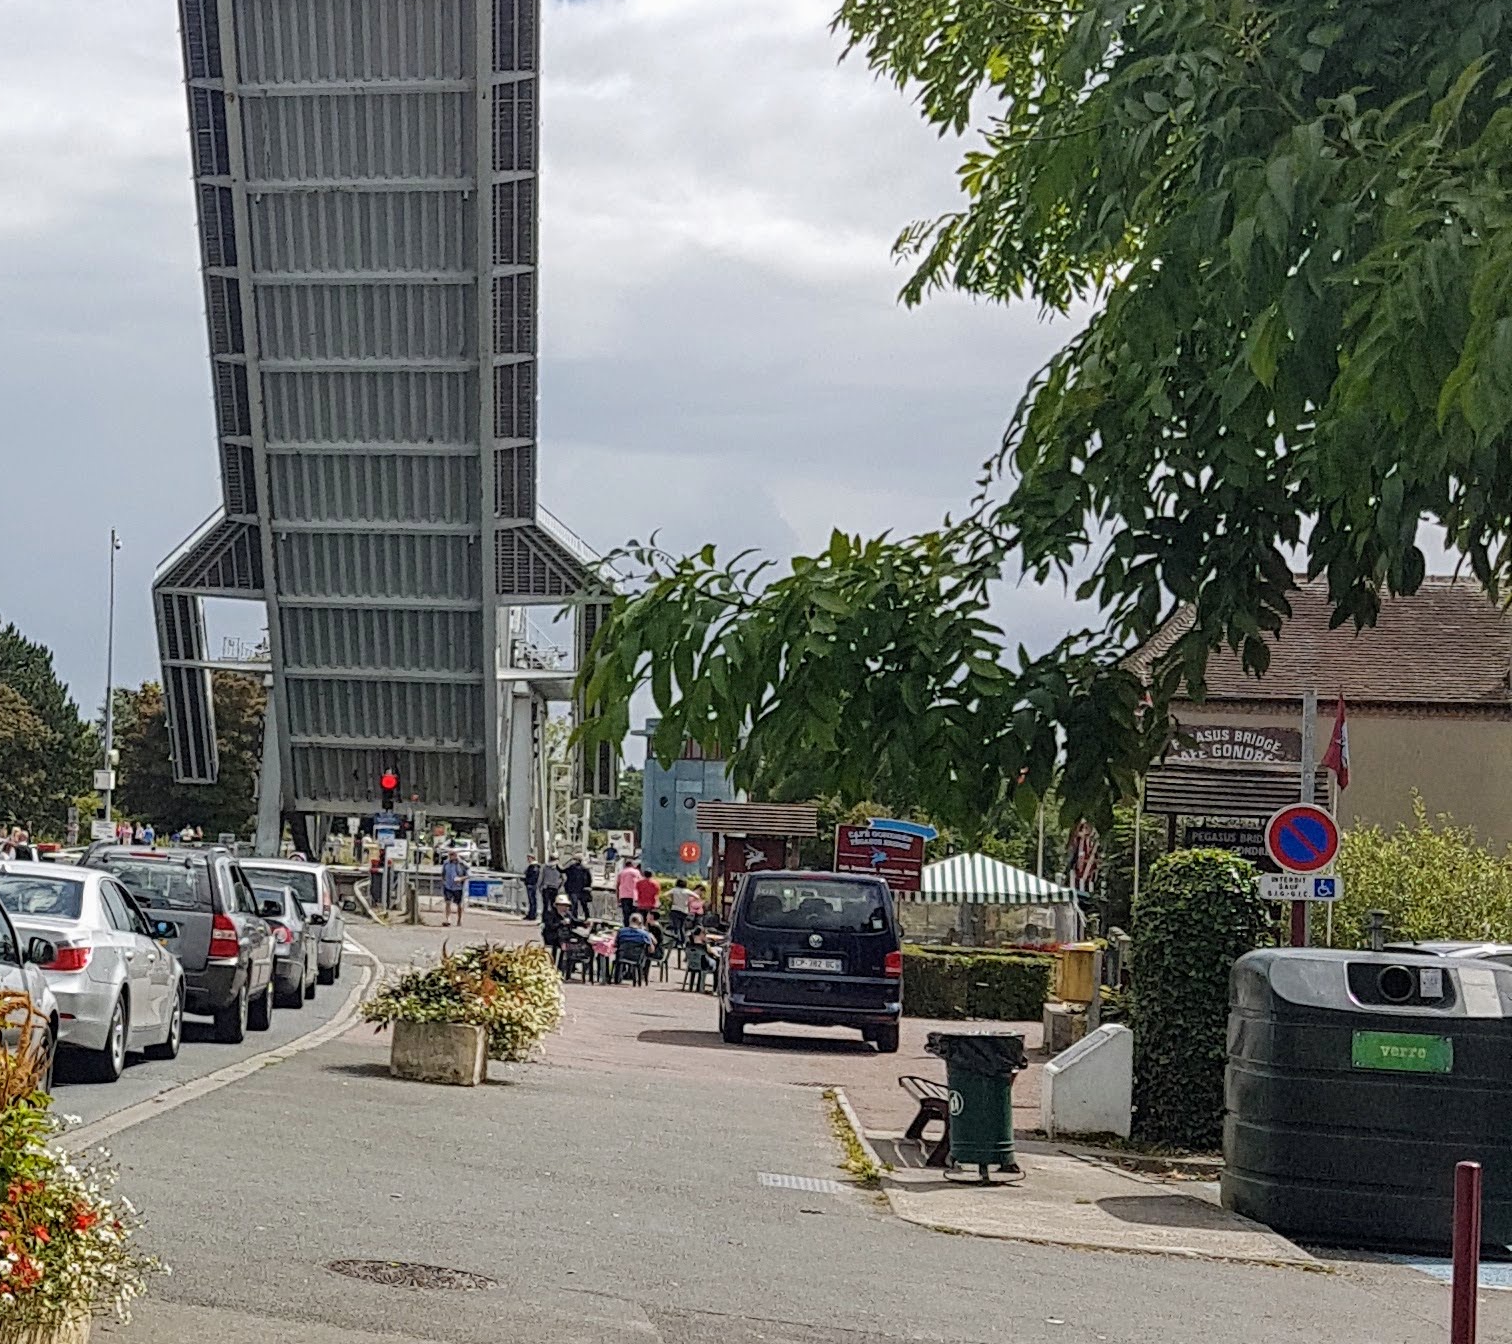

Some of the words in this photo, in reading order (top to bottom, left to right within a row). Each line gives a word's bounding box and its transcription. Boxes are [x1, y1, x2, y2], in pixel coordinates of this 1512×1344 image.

[1171, 729, 1230, 750] PASUS
[1234, 730, 1284, 755] BRIDGE
[1191, 831, 1237, 843] PEGASUS
[1239, 833, 1267, 844] BRID
[1271, 876, 1306, 884] INTERDIT
[1380, 1045, 1427, 1059] verre
